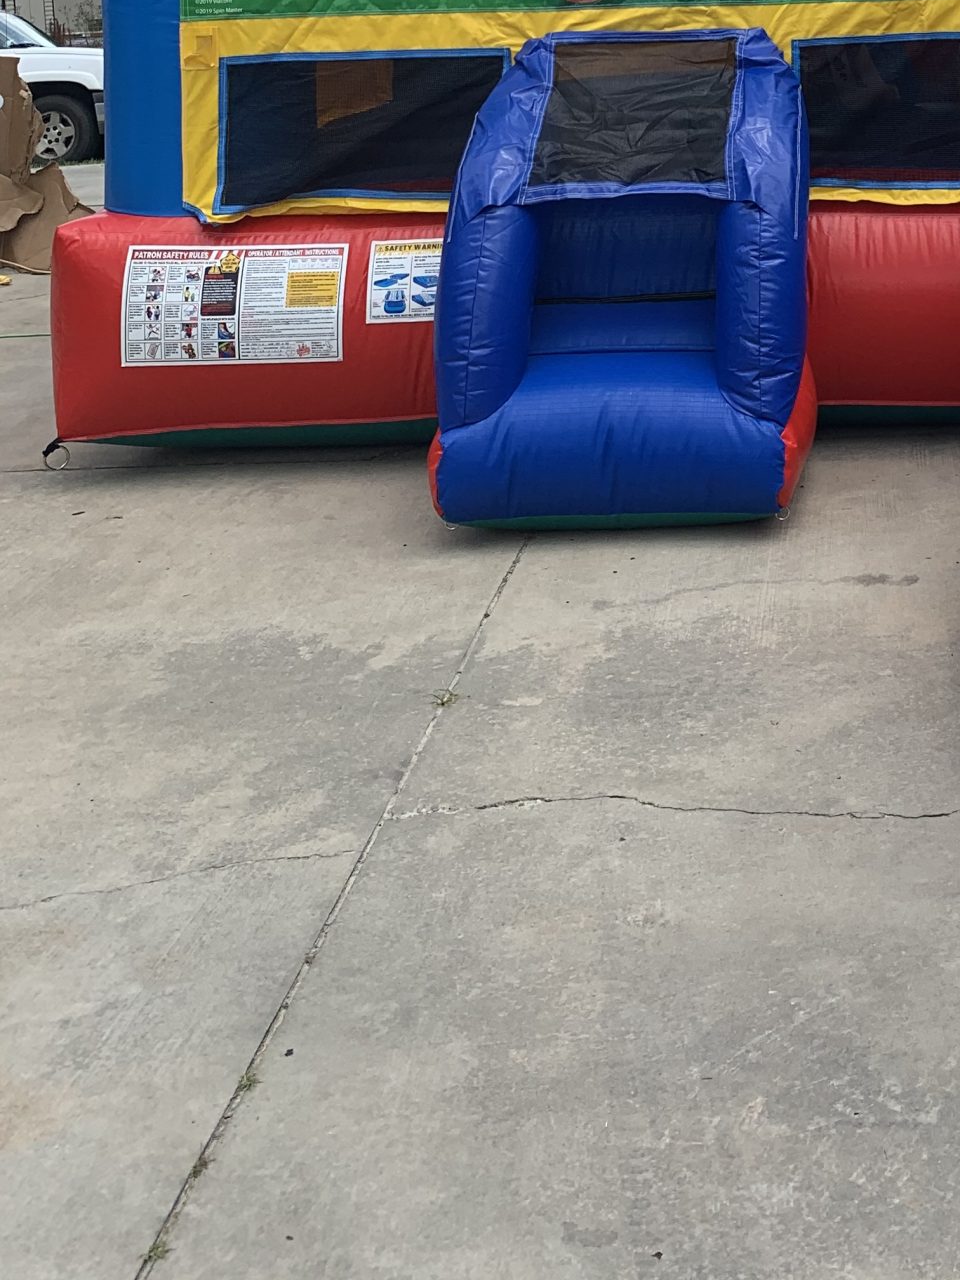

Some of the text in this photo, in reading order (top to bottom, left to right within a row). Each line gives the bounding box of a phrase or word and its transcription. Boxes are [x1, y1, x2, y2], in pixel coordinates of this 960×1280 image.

[133, 251, 209, 259] PATRON SAFETY RULES
